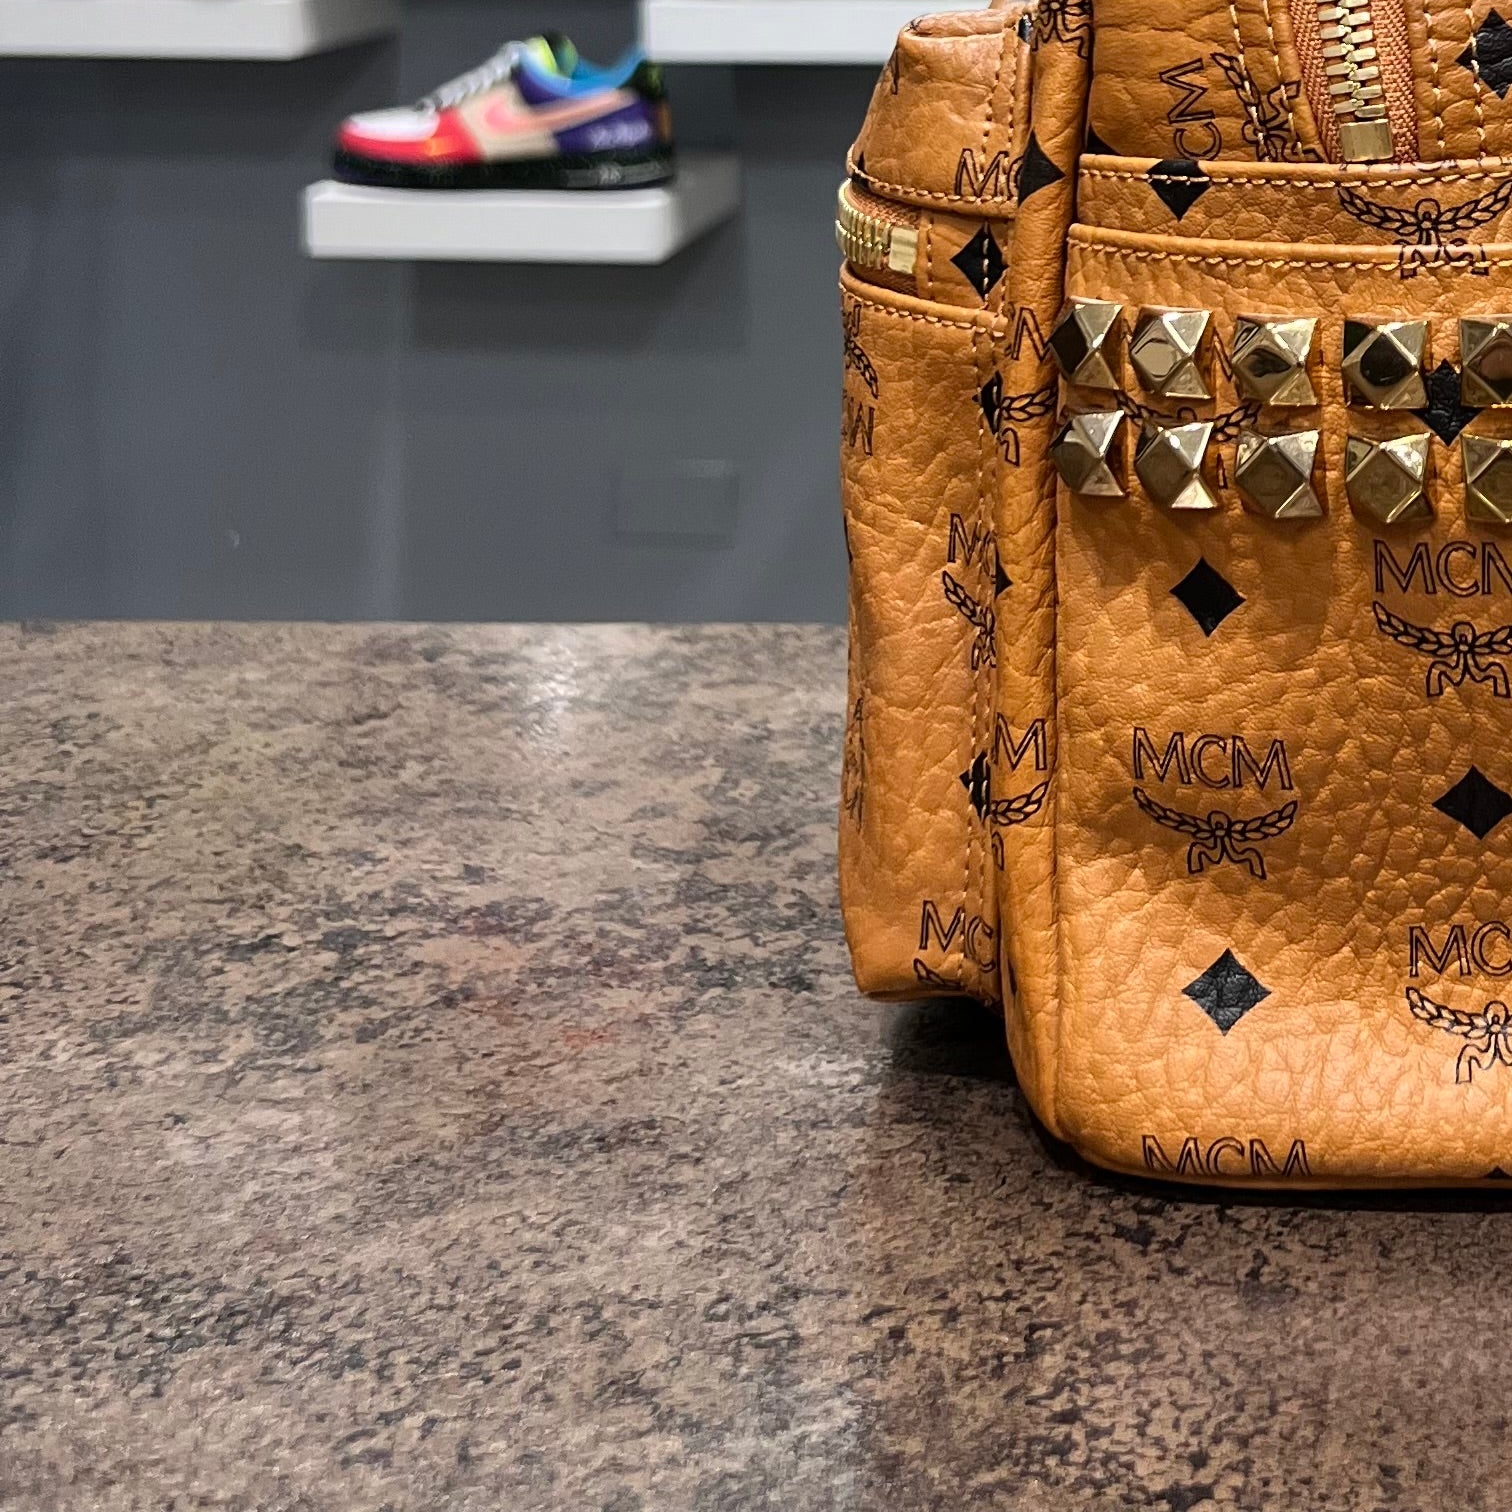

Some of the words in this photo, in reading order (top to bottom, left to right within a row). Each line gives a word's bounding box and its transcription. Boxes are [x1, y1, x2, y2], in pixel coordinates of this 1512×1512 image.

[1159, 58, 1222, 161] CM
[1133, 726, 1294, 791] MCM
[918, 899, 997, 973] MC
[1141, 1134, 1313, 1177] MCM
